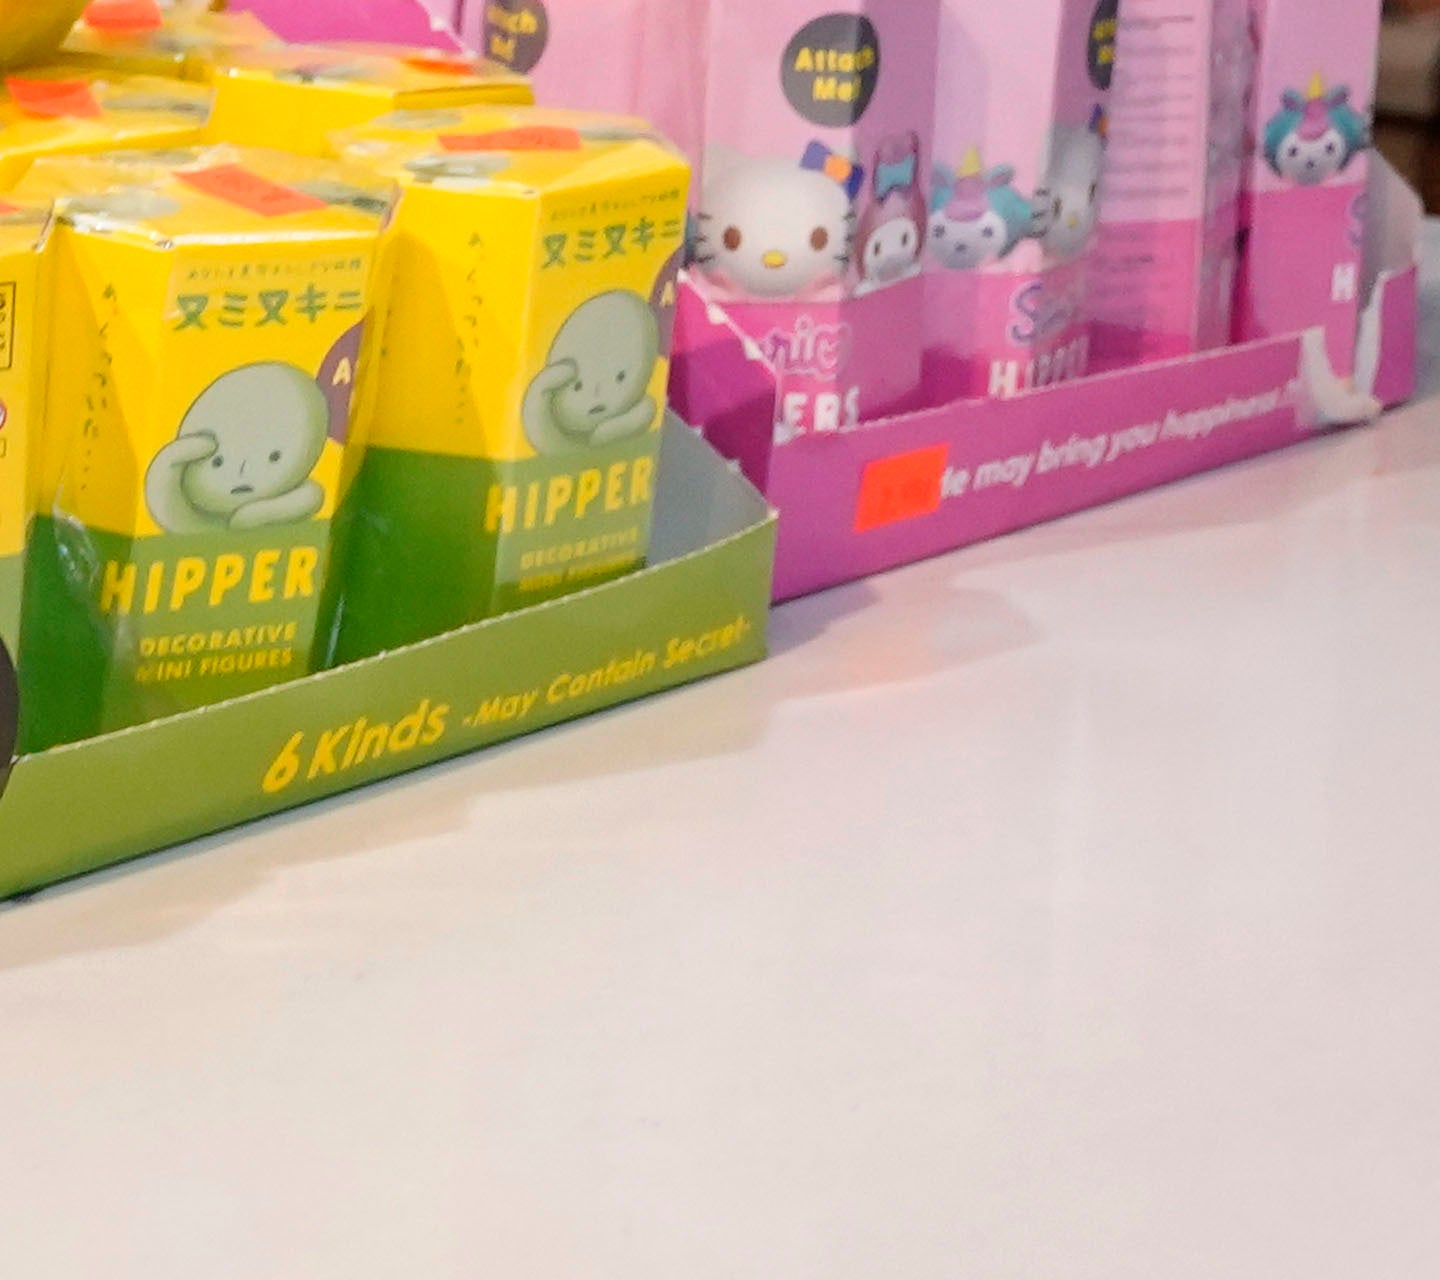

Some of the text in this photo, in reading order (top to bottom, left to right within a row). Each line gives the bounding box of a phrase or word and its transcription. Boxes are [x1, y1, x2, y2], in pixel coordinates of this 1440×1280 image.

[483, 455, 655, 534] HIPPER
[973, 453, 1034, 490] may
[100, 545, 320, 617] HIPPER
[139, 622, 297, 656] DECORATIVE
[199, 648, 293, 677] FIGURES
[262, 731, 304, 794] 6
[306, 699, 451, 781] Kinds
[546, 651, 657, 704] Contain
